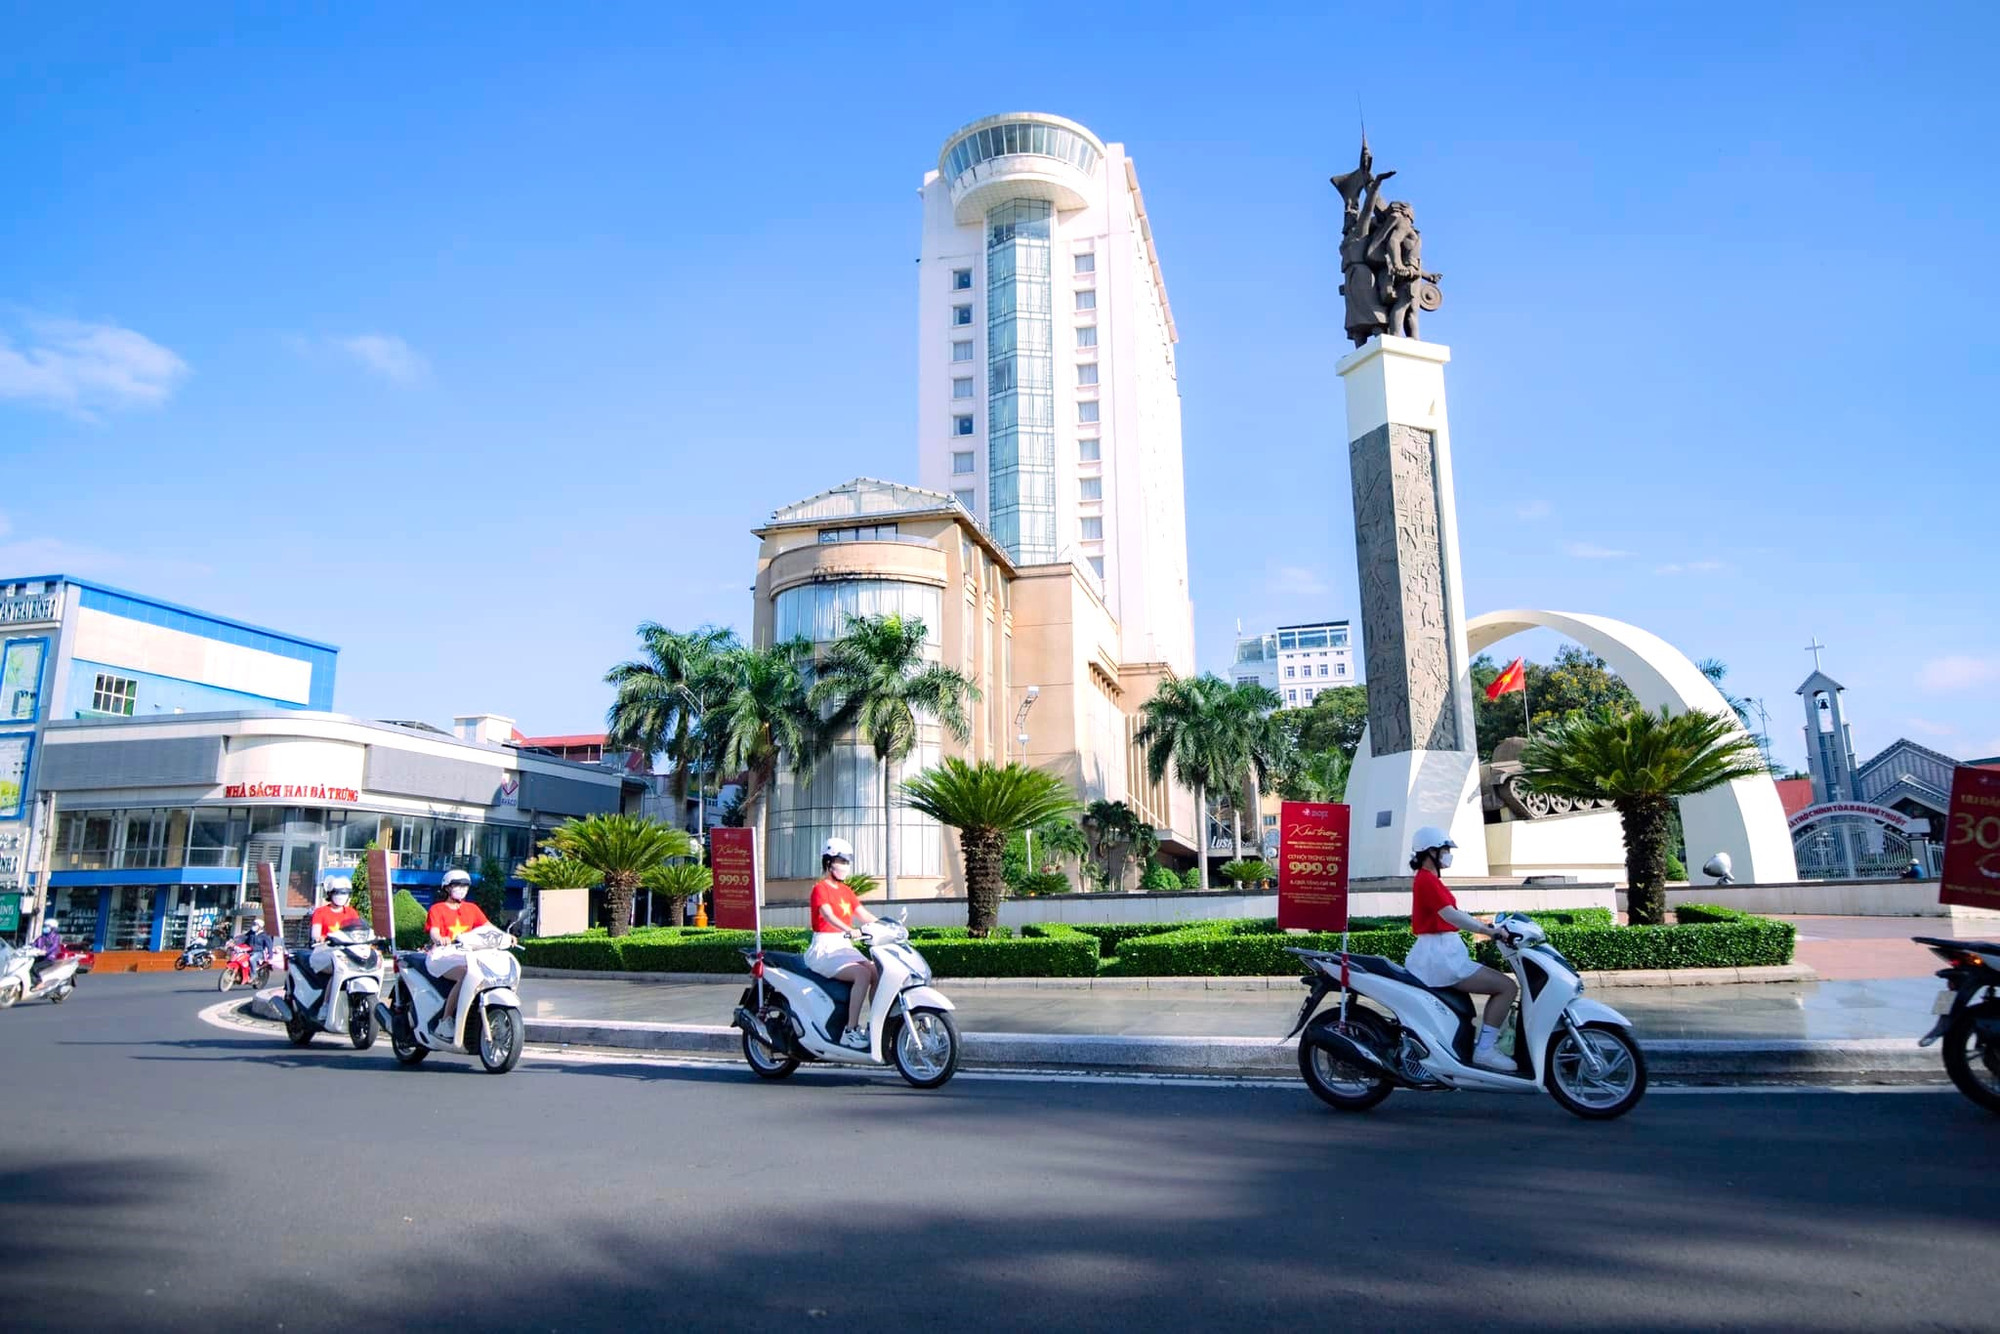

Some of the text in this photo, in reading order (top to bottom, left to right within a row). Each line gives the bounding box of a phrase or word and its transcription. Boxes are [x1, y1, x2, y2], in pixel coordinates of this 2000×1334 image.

[226, 782, 246, 798] NHÀ
[249, 781, 281, 798] SÁCH
[284, 785, 308, 798] HAI
[310, 783, 326, 799] BÀ
[1289, 861, 1338, 876] 999.9
[718, 874, 750, 886] 999.9
